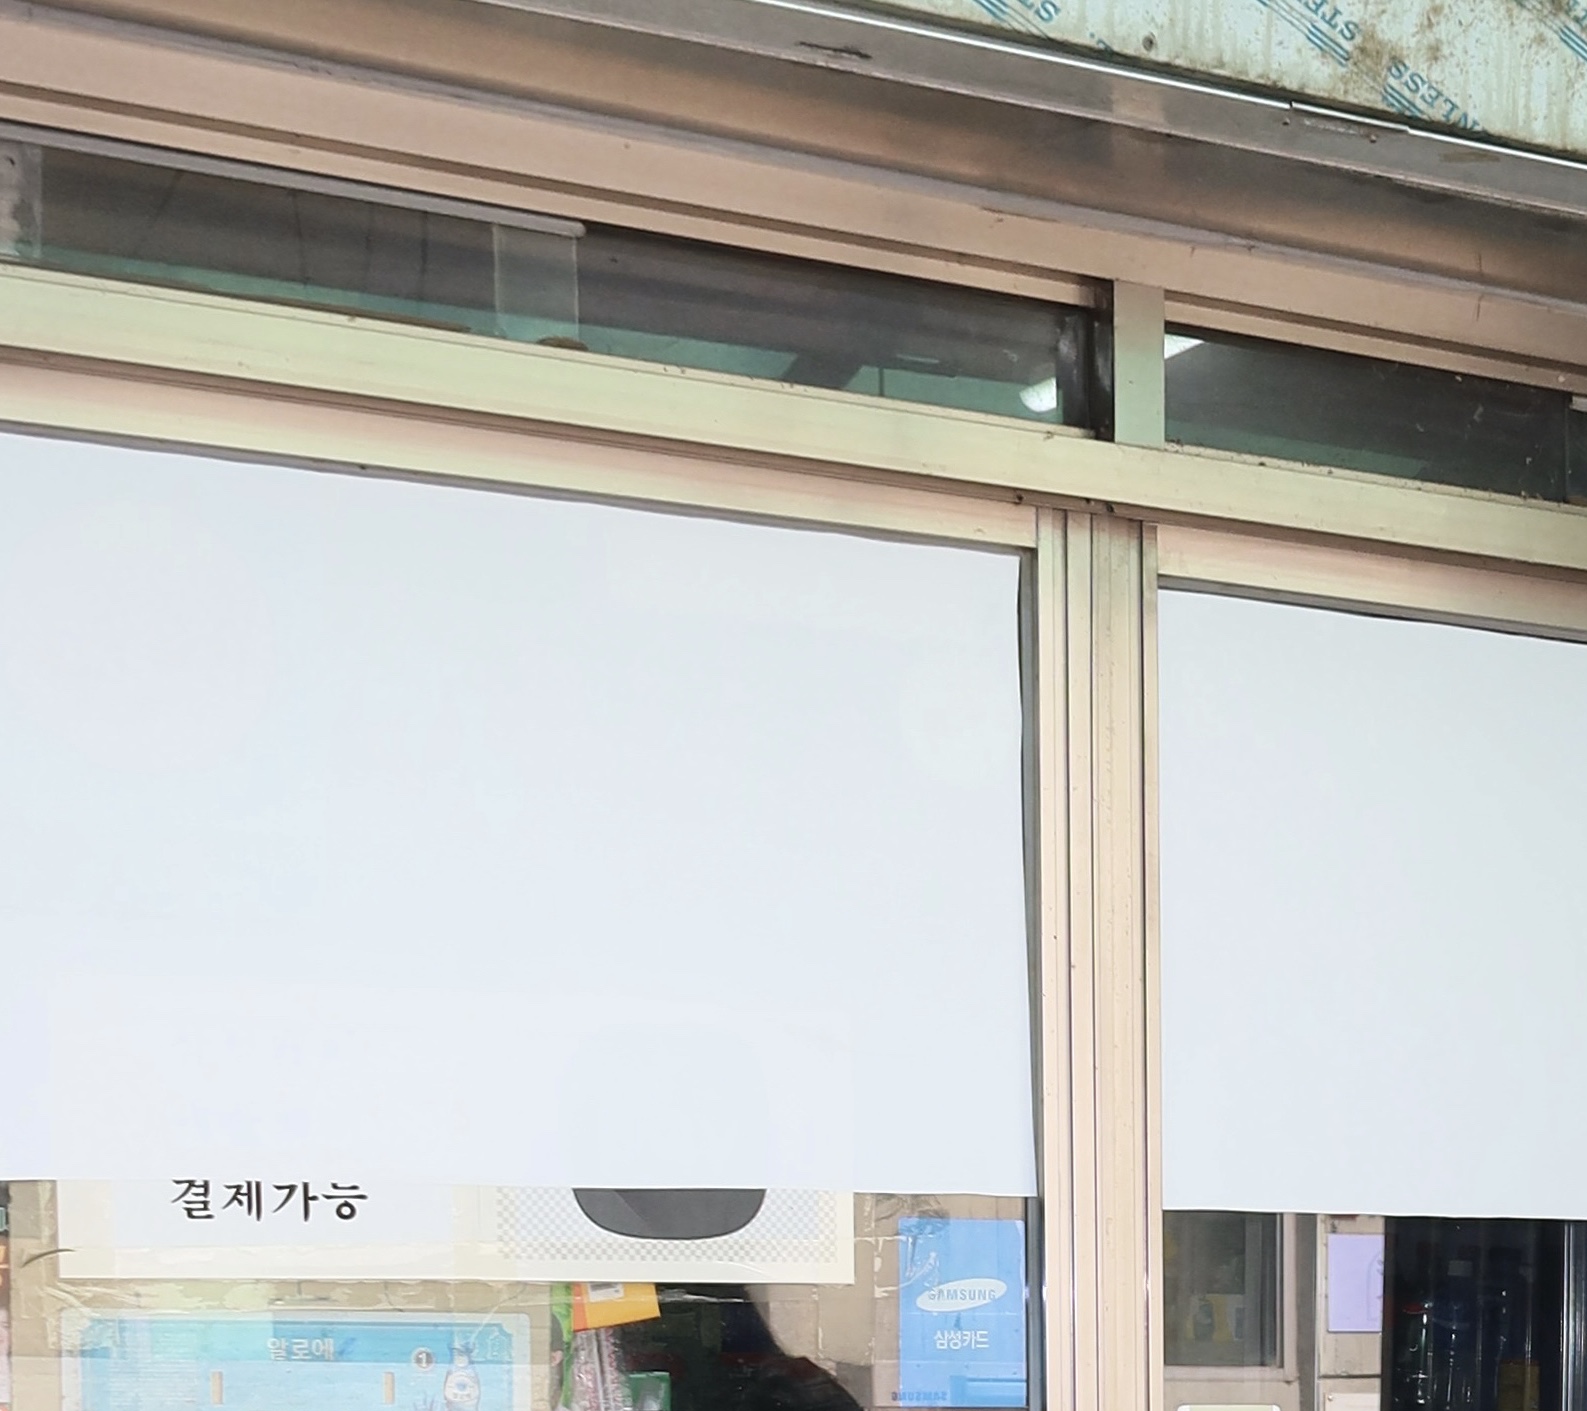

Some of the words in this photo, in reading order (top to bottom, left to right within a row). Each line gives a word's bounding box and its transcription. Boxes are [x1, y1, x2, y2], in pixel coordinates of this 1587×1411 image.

[171, 1179, 368, 1223] 결제가능
[928, 1287, 997, 1301] SAMSUNG
[267, 1337, 335, 1361] 알로에
[934, 1330, 990, 1350] 삼성카드
